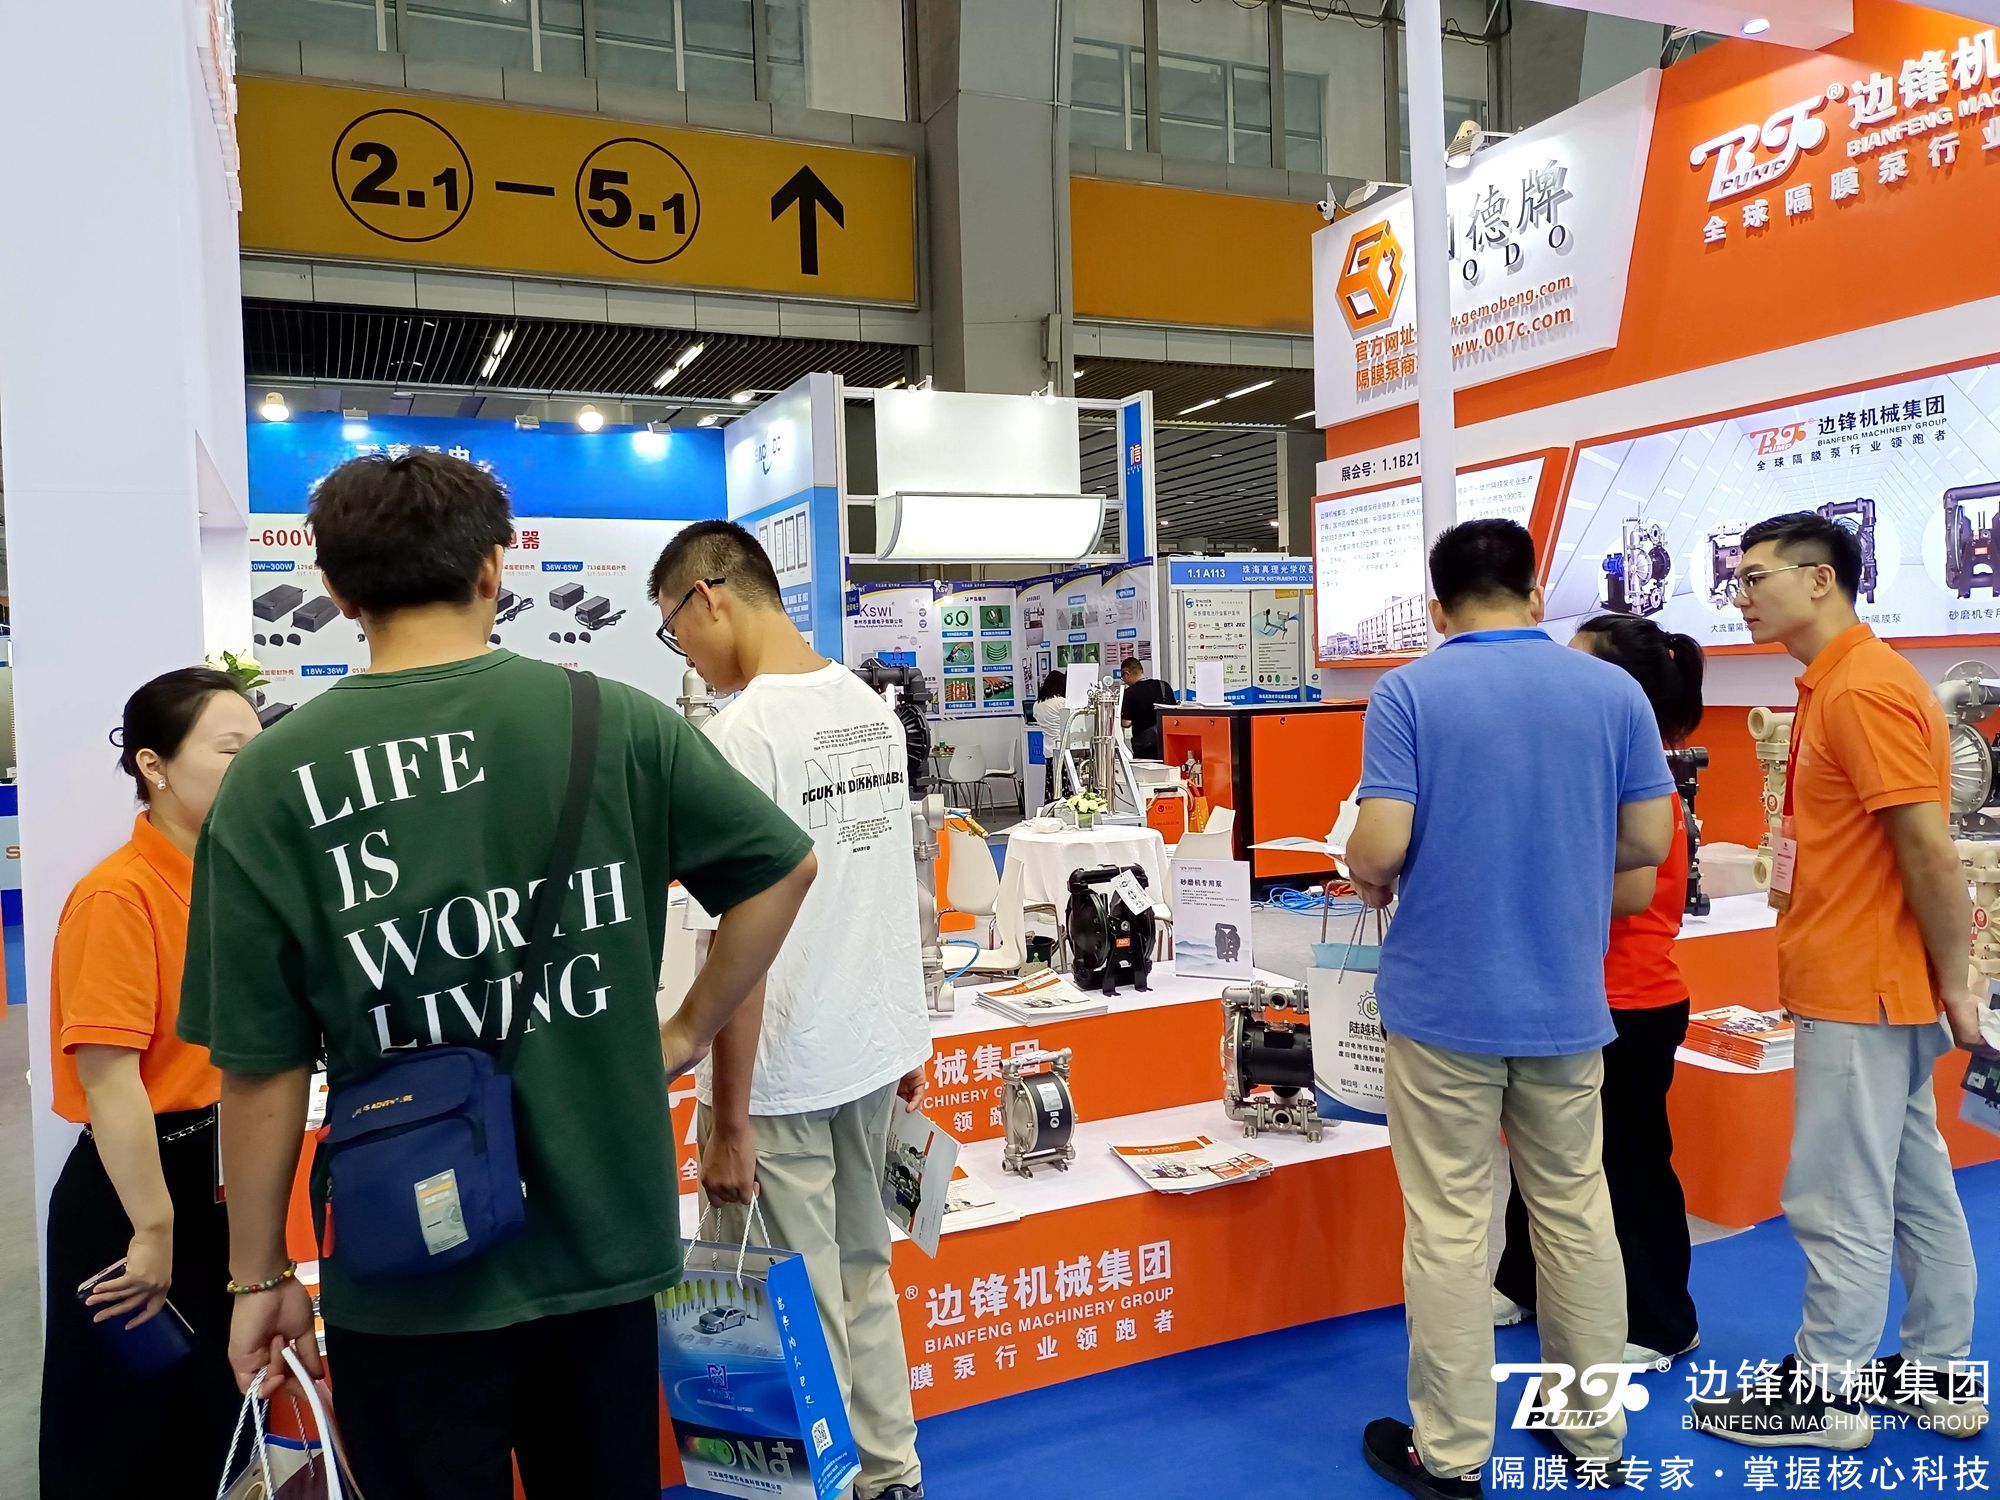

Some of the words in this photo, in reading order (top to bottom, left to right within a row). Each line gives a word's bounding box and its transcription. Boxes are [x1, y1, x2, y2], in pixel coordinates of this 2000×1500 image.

[1846, 106, 1954, 158] BIANFENG
[349, 141, 459, 212] 2.1
[586, 168, 686, 235] 5.1
[1355, 323, 1416, 363] 官方网址
[1817, 433, 1859, 447] BIANFENG
[1861, 423, 1913, 439] MACHINERY
[1915, 417, 1948, 430] GROUP
[1818, 394, 1946, 437] 边锋机械集团
[1756, 429, 1947, 472] 全球隔膜泵行业领跑者
[1187, 568, 1201, 578] 1.1
[1203, 568, 1226, 578] A113
[290, 730, 486, 830] LIFE
[325, 828, 400, 912] IS
[1180, 878, 1223, 889] 砂磨机专用泵
[925, 1039, 1042, 1090] 械集团
[920, 1088, 989, 1110] CHINERY
[924, 1239, 1173, 1330] 边锋机械集团
[924, 1321, 1013, 1354] BIANFENG
[1017, 1298, 1117, 1333] MACHINERY
[1119, 1286, 1175, 1311] GROUP
[909, 1308, 1175, 1392] 膜泵行业领跑者
